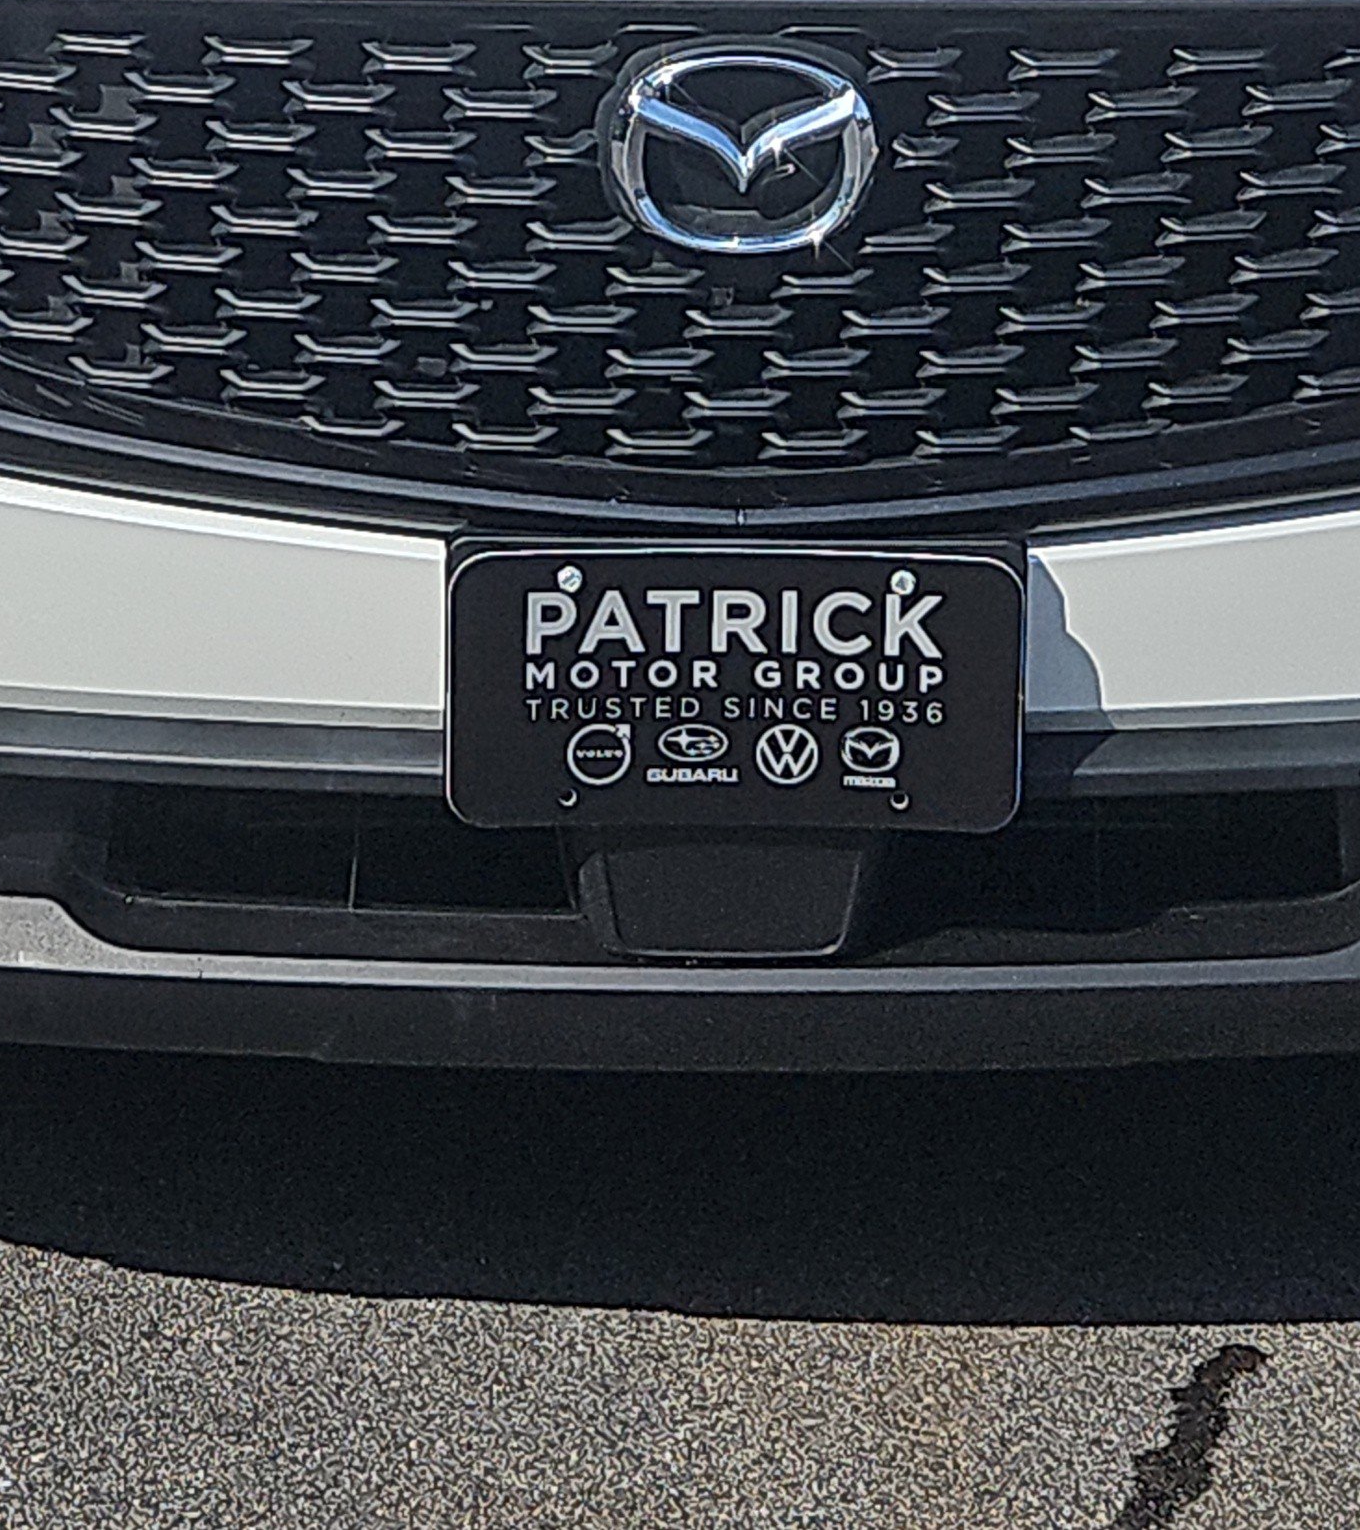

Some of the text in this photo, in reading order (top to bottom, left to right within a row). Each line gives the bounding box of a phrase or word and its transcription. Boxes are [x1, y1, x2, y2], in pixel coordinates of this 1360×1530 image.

[525, 589, 943, 659] PATRICK
[526, 660, 943, 693] MOTOR GROUP
[526, 698, 944, 724] TRUSTED SINCE 1936
[646, 768, 739, 783] SUBARU
